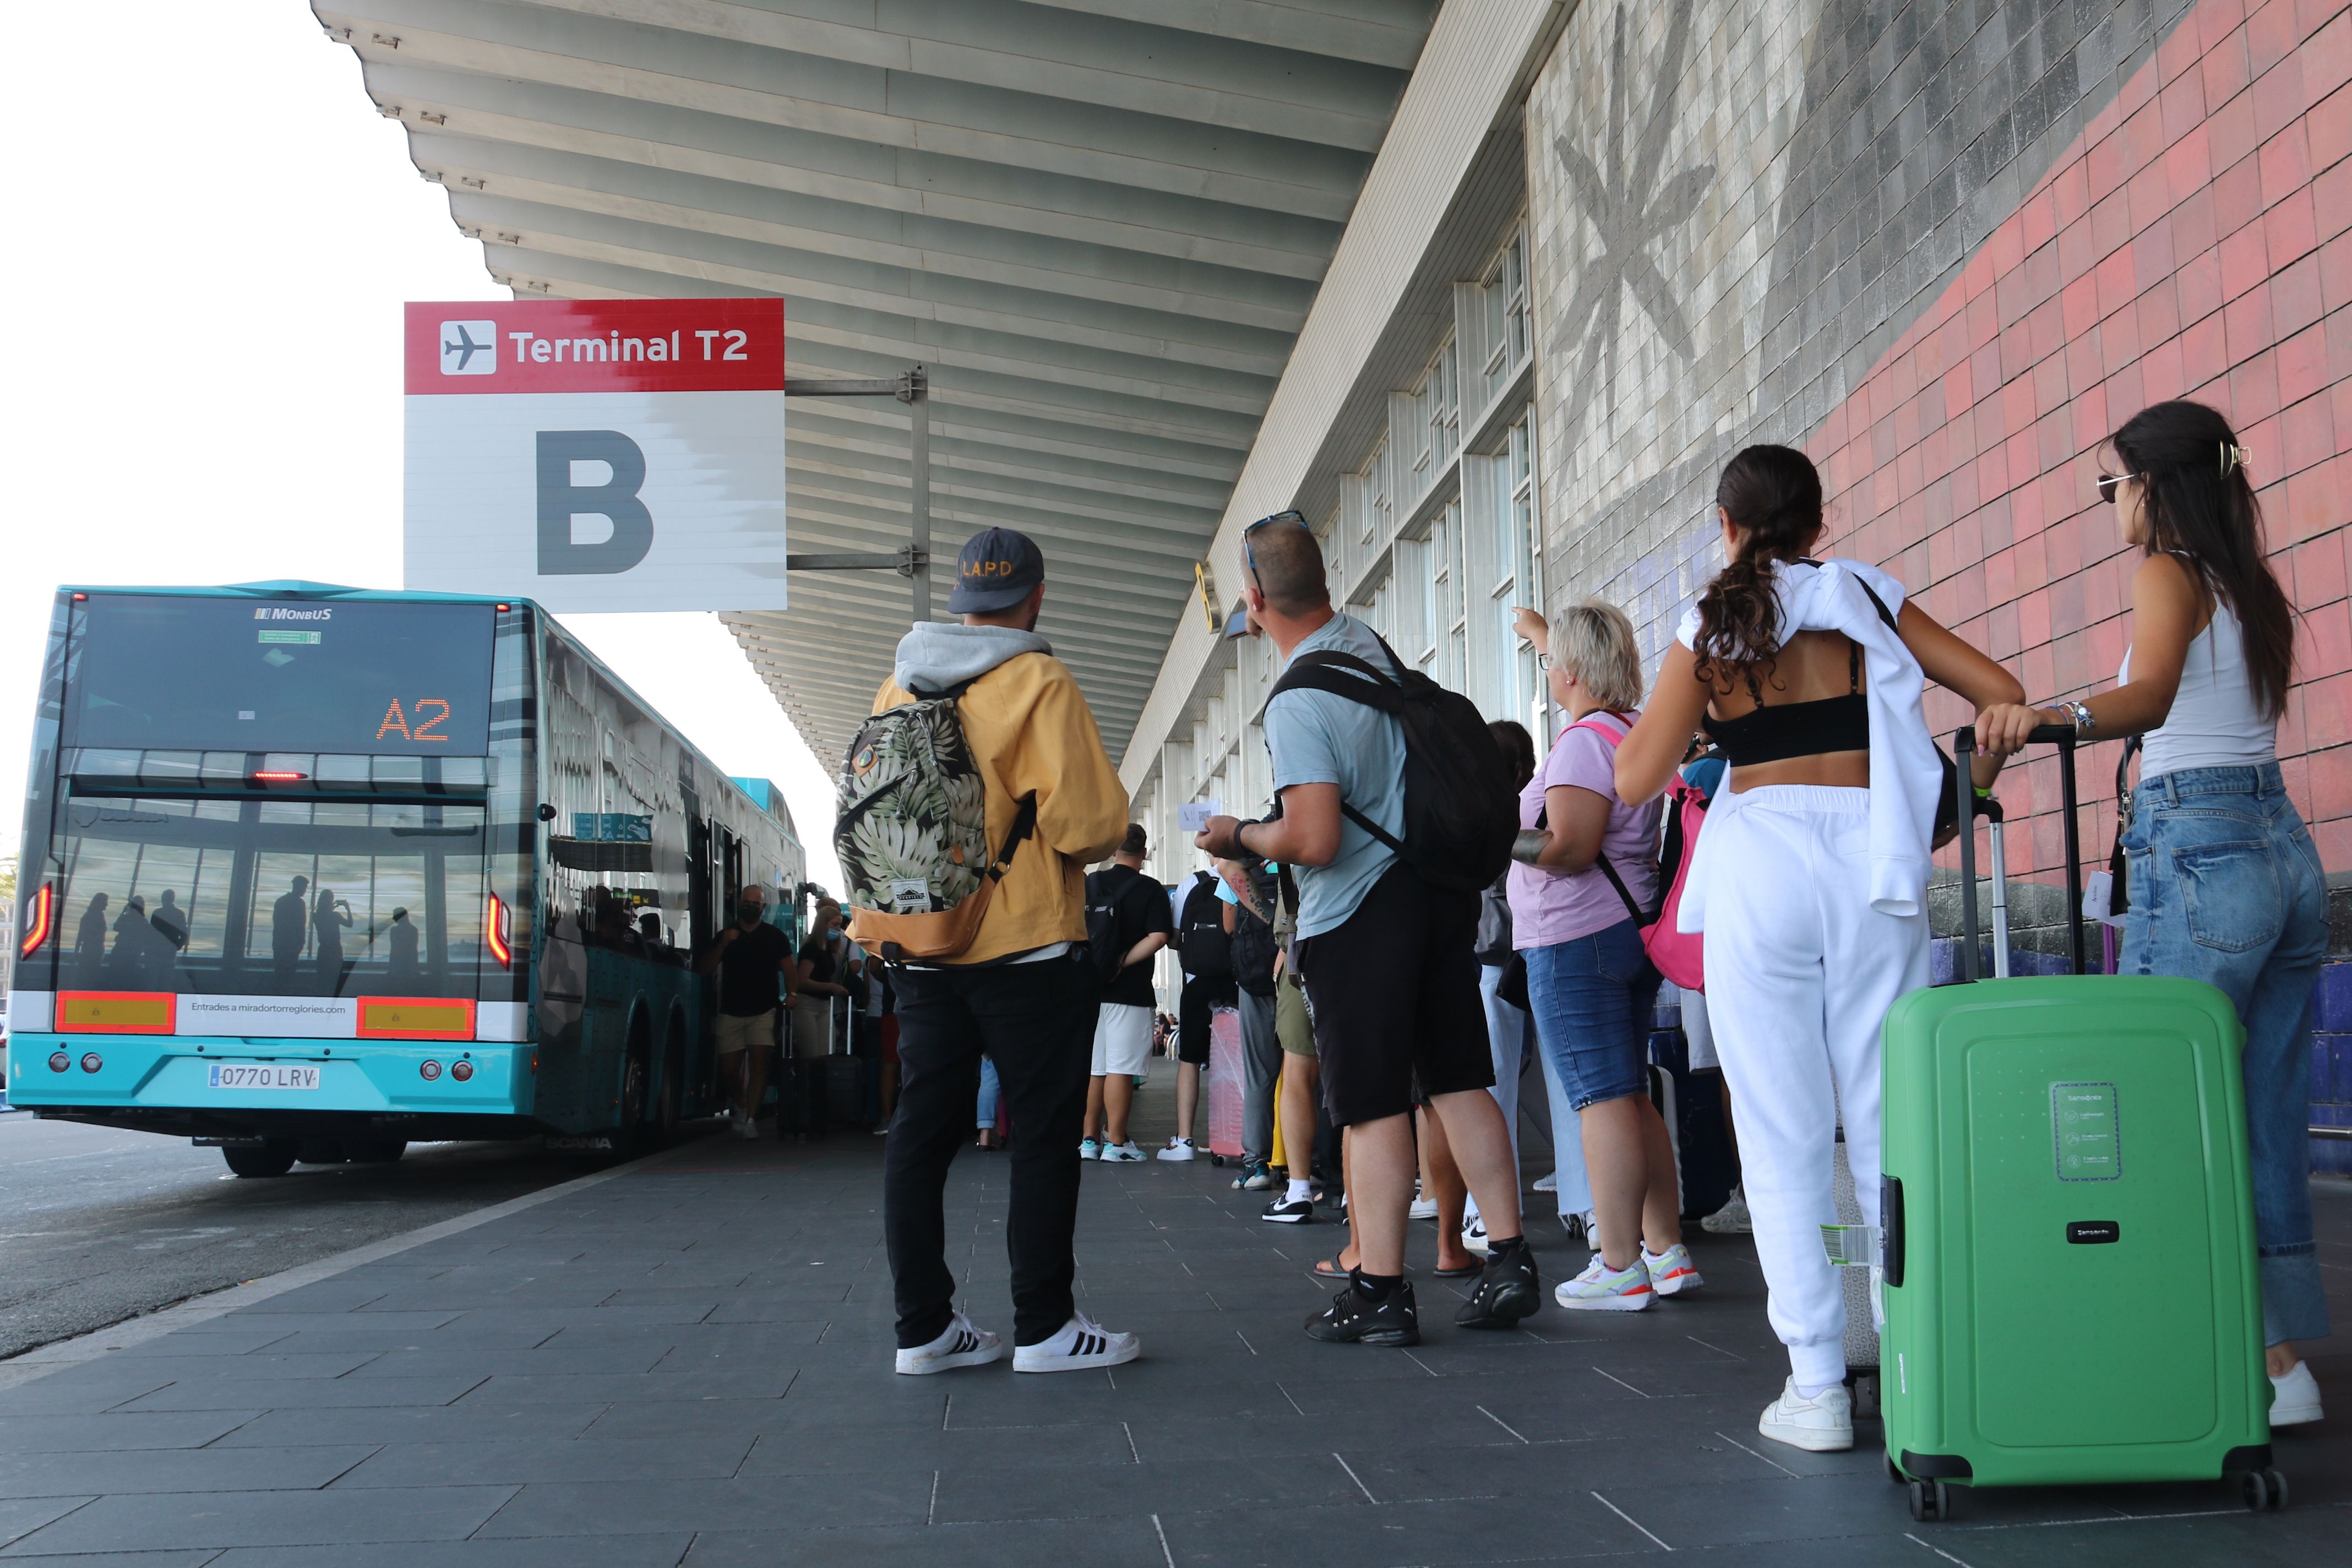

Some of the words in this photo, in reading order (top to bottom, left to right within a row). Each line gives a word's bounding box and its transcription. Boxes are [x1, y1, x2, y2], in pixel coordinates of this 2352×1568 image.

[509, 330, 679, 363] Terminal
[695, 330, 748, 361] T2
[536, 429, 654, 575] B
[376, 698, 450, 741] A2
[192, 1003, 230, 1011] Entrades
[238, 1004, 346, 1014] miradortorreglories.com
[223, 1068, 271, 1085] 0770
[278, 1069, 313, 1086] LRV
[546, 1137, 612, 1148] SCANIA
